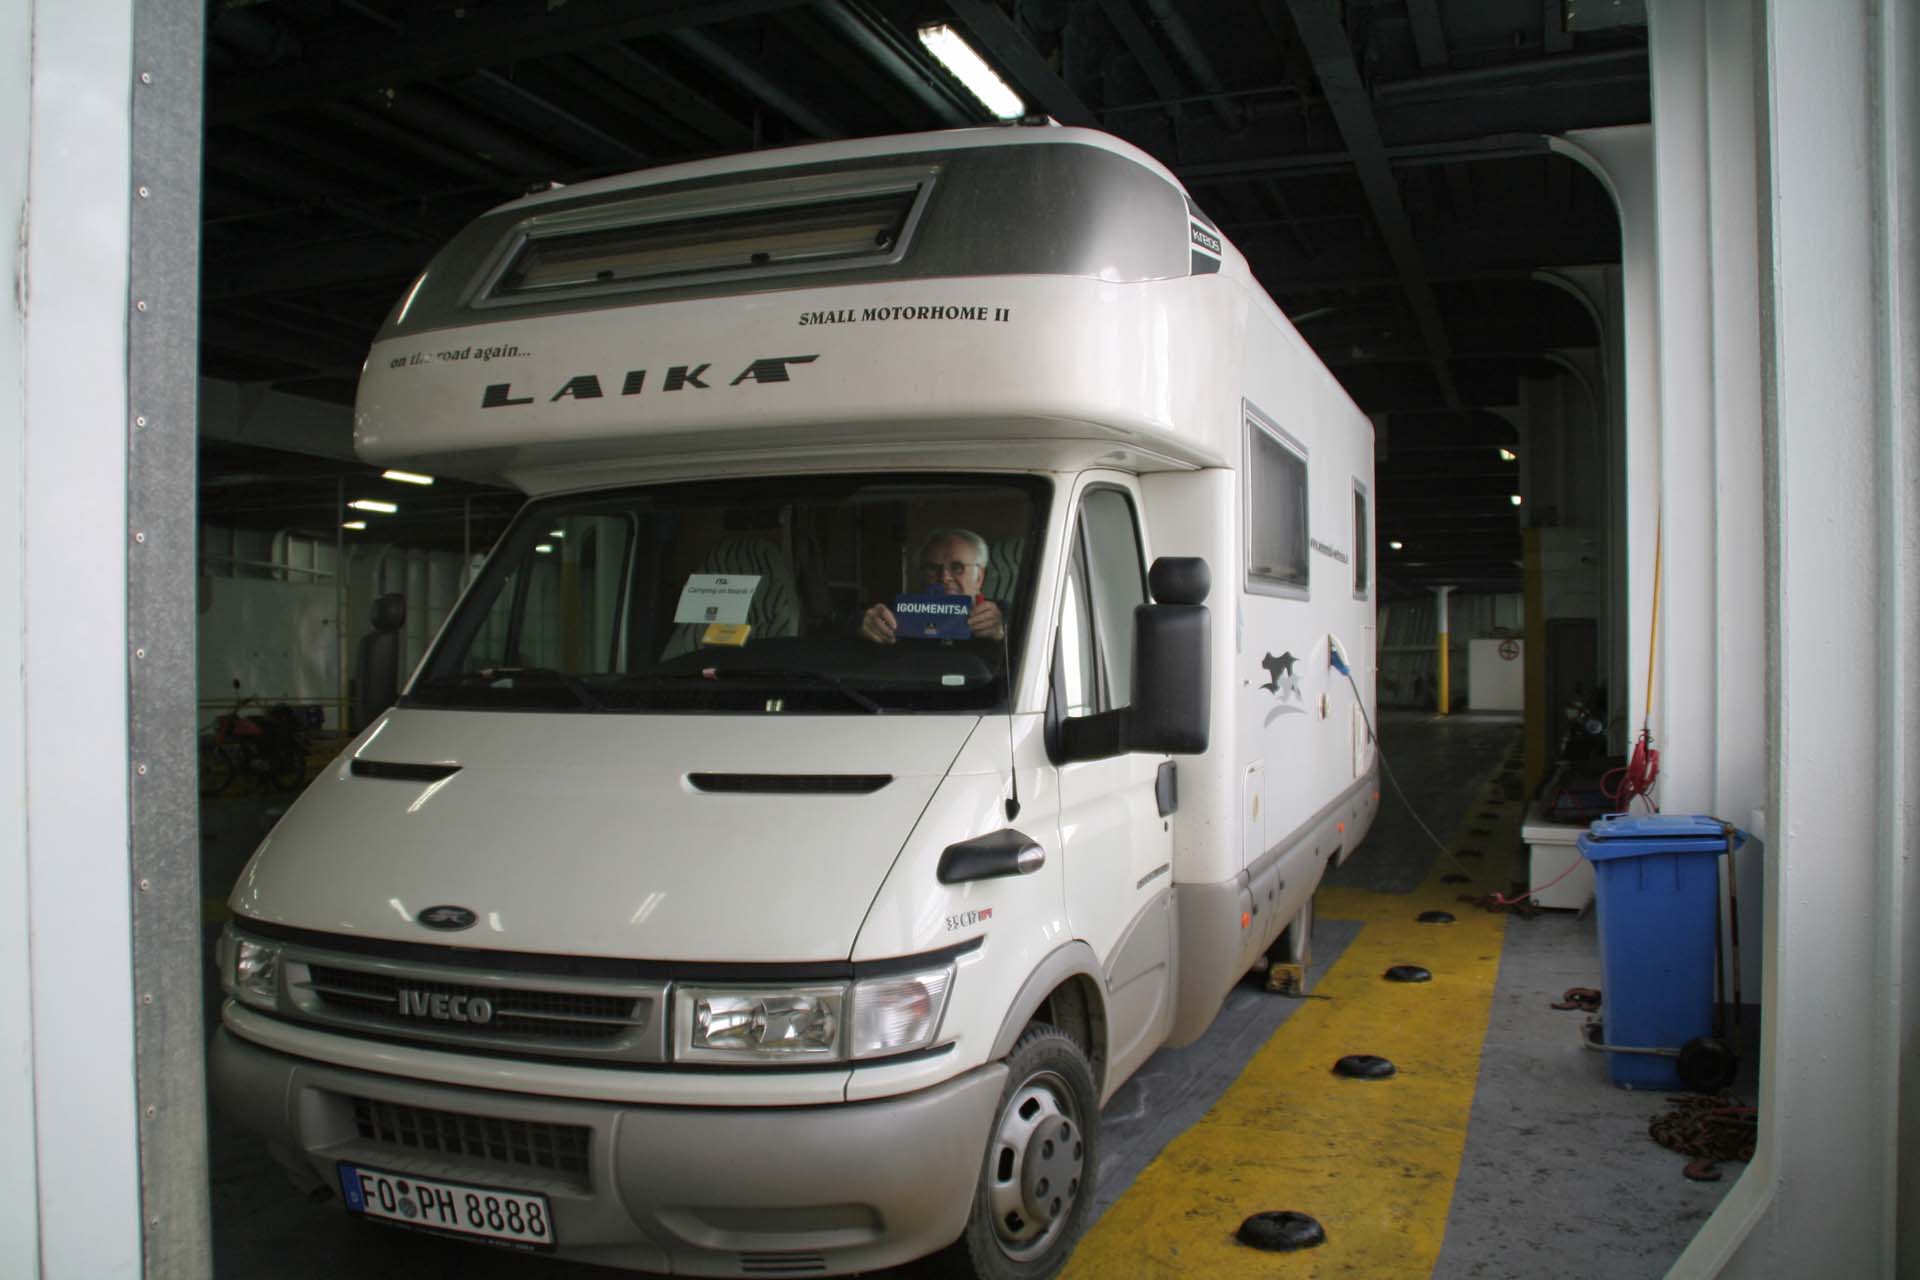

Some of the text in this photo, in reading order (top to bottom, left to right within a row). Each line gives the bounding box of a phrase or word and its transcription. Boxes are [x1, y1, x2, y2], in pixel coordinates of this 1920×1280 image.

[797, 305, 1010, 326] SMALL MOTORHOME II
[389, 355, 407, 369] on
[437, 346, 472, 362] road
[474, 344, 531, 362] again...
[480, 353, 821, 409] LAIKA
[896, 602, 969, 616] IGOUMENITSA
[398, 989, 493, 1024] IVECO
[358, 1174, 397, 1213] FO
[415, 1185, 458, 1225] PH
[464, 1193, 546, 1237] 8888
